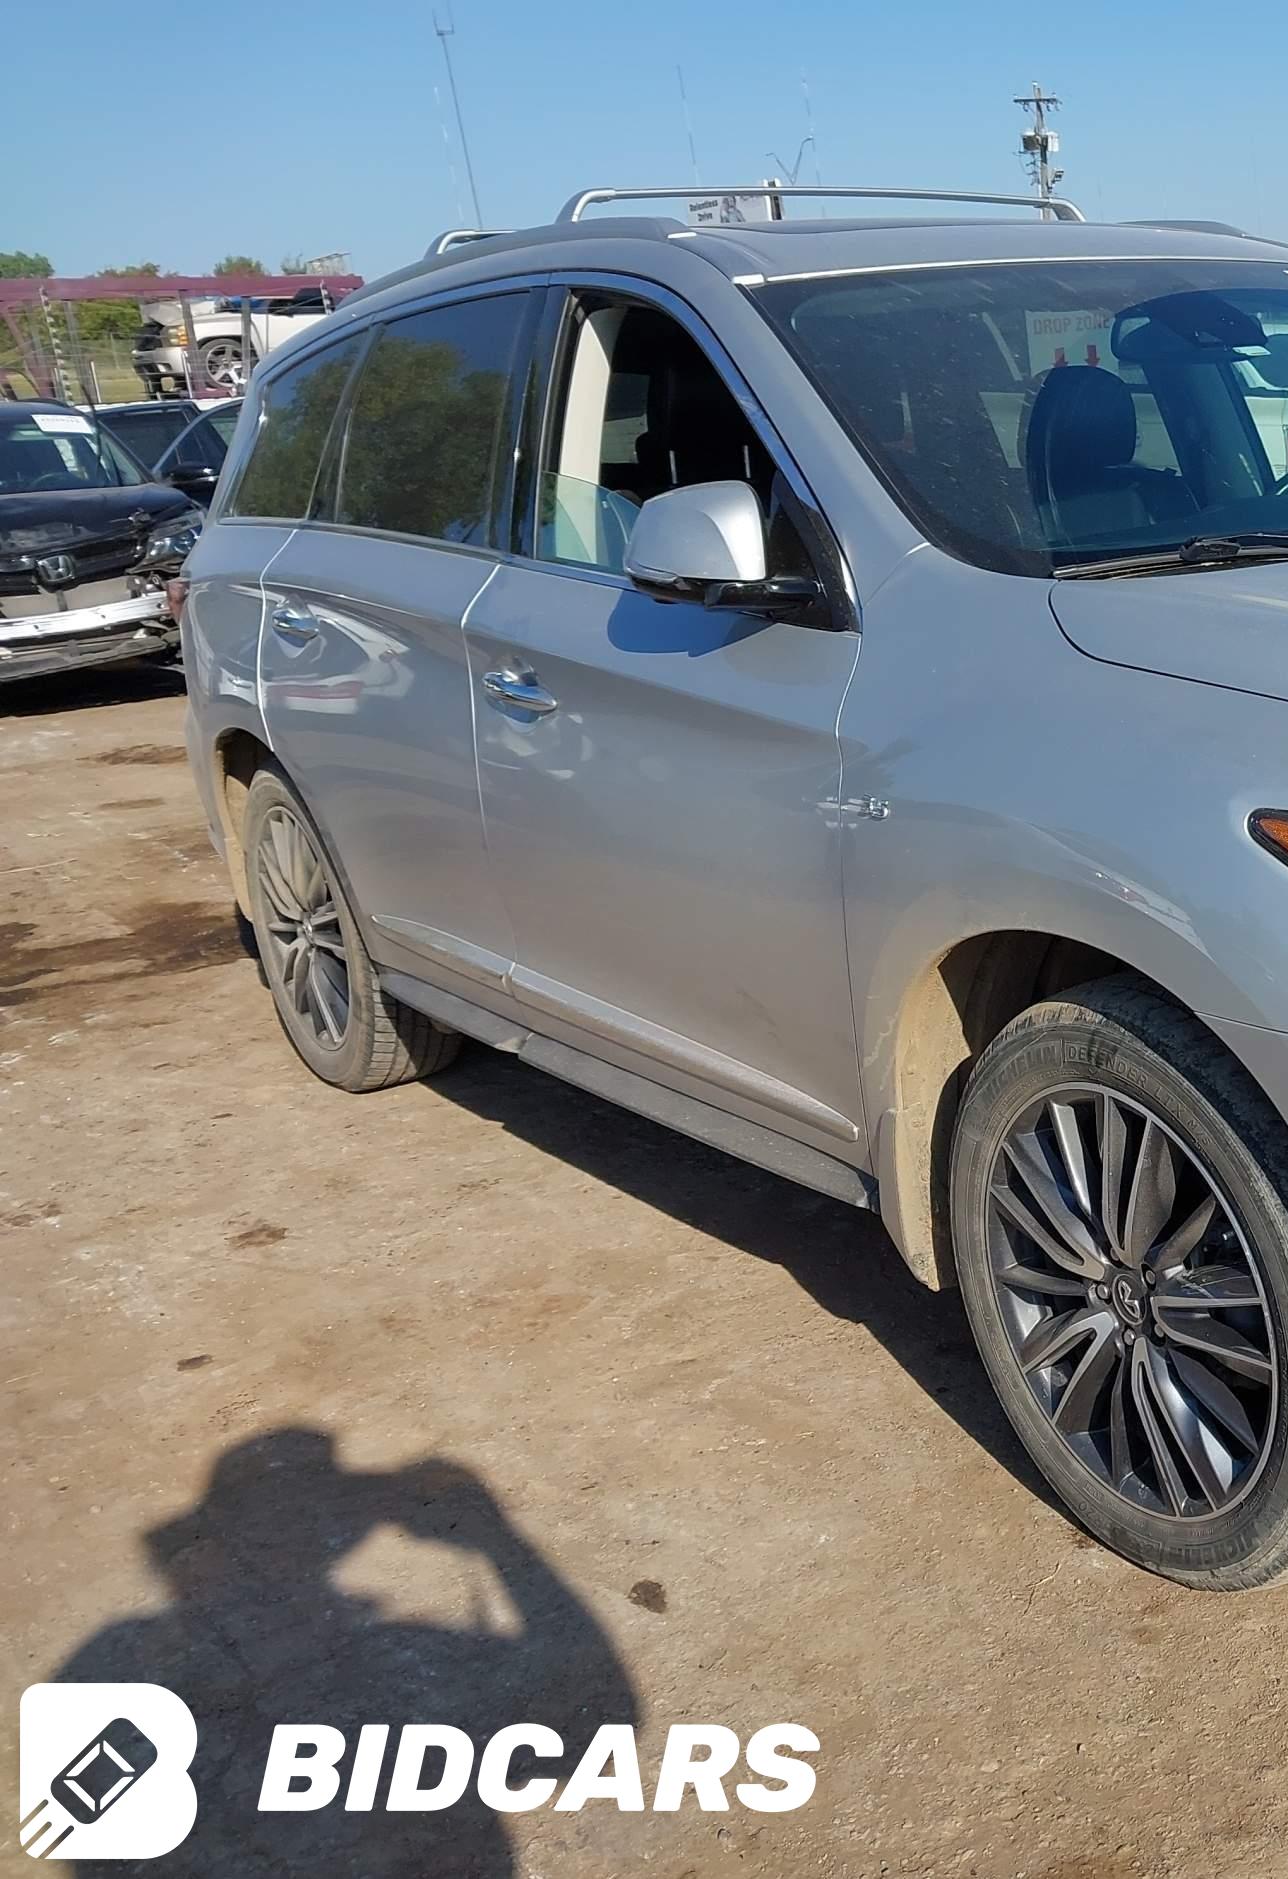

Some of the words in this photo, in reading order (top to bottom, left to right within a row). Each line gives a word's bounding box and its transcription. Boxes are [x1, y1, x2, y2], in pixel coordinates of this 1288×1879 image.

[1033, 317, 1071, 335] DROP
[1076, 312, 1110, 332] ZONE
[1067, 1044, 1149, 1089] DEFENDER
